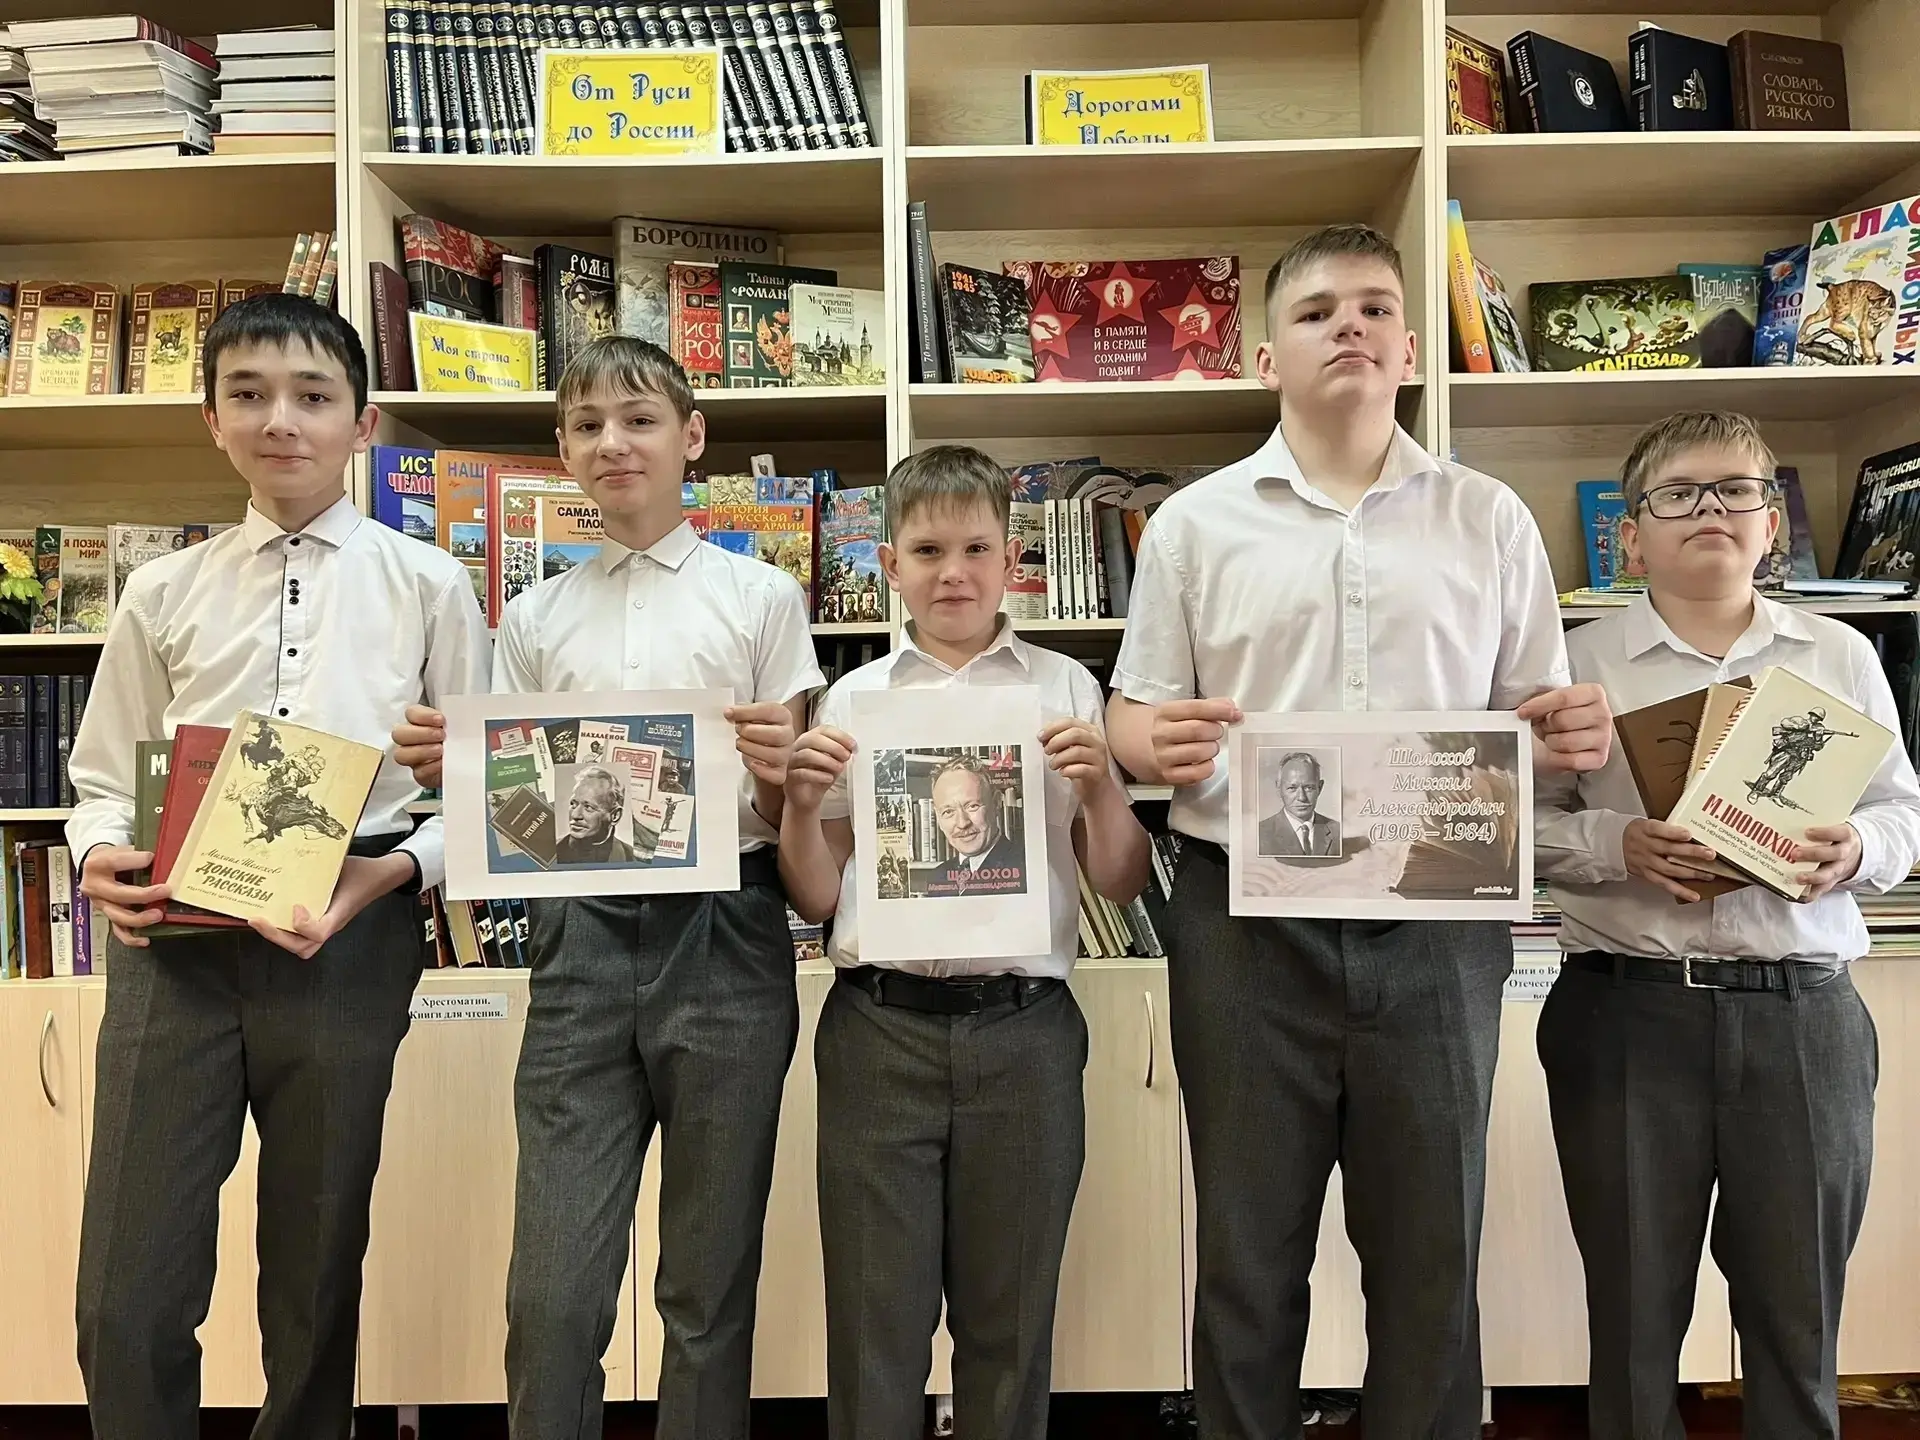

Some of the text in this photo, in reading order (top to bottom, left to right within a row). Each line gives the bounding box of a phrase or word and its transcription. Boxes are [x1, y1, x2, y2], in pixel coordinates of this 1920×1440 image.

[400, 50, 412, 118] ЭНЦИКЛОПЕДИЯ
[424, 51, 437, 119] ЭНЦИКЛОПЕДИЯ
[445, 52, 459, 120] ЭНЦИКЛОПЕДИЯ
[467, 53, 483, 120] ЭНЦИКЛОПЕДИЯ
[490, 53, 506, 121] ЭНЦИКЛОПЕДИЯ
[509, 52, 527, 120] ЭНЦИКЛОПЕДИЯ
[572, 74, 614, 101] От
[628, 72, 691, 106] Руси
[730, 54, 758, 118] ЭНЦИКЛОПЕДИЯ
[752, 53, 778, 117] ЭНЦИКЛОПЕДИЯ
[771, 53, 798, 116] ЭНЦИКЛОПЕДИЯ
[794, 51, 820, 115] ЭНЦИКЛОПЕДИЯ
[815, 50, 841, 115] ЭНЦИКЛОПЕДИЯ
[836, 48, 861, 114] ЭНЦИКЛОПЕДИЯ
[1763, 73, 1824, 91] СЛОВАРЬ
[1062, 90, 1182, 119] Дорогами
[1765, 88, 1835, 109] РУССКОГО
[1766, 104, 1813, 121] ЯЗЫКА
[566, 112, 696, 143] до России
[1078, 123, 1171, 145] Победы
[428, 139, 434, 148] 1
[451, 141, 458, 150] 2
[476, 141, 482, 150] 3
[499, 140, 507, 150] 4
[521, 139, 528, 149] 5
[1813, 198, 1920, 247] АТЛАС
[632, 226, 768, 254] БОРОДИНО
[952, 279, 976, 294] 1945
[1454, 252, 1475, 323] ЭНЦИКЛОПЕДИЯ
[1094, 325, 1147, 338] В ПАМЯТИ
[431, 335, 510, 364] Моя страна
[1094, 338, 1147, 351] И В СЕРДЦЕ
[1094, 351, 1147, 365] СОХРАНИМ
[438, 365, 521, 389] моя Отчизна
[448, 462, 492, 479] НАШ
[503, 481, 562, 490] ЭНЦИКЛОПЕДИЯ
[557, 507, 599, 518] САМАЯ
[714, 505, 769, 514] ИСТОРИЯ
[733, 513, 787, 522] РУССКОЙ
[763, 522, 805, 530] АРМИИ
[64, 539, 108, 549] Я ПОЗНА
[79, 550, 101, 559] МИР
[1052, 607, 1057, 615] 1
[1064, 607, 1070, 615] 2
[1078, 606, 1083, 615] 3
[1090, 604, 1097, 614] 4
[648, 727, 682, 737] ШОЛОХОВ
[988, 751, 1014, 771] 24
[1387, 746, 1476, 767] Шолохов
[1392, 773, 1472, 792] Михаил
[1358, 797, 1506, 821] Александрович
[1368, 822, 1498, 845] (1905 1984)
[1705, 819, 1717, 829] ОНИ
[1718, 826, 1748, 848] СРАЖАЛИСЬ
[1756, 849, 1778, 864] РОДИНУ
[1690, 819, 1706, 831] НАУКА
[1759, 858, 1784, 877] ЧЕЛОВЕКА
[201, 848, 283, 874] Михаил Шолохов
[195, 861, 266, 886] ДОНСКИЕ
[947, 868, 1020, 881] ШОЛОХОВ
[202, 875, 274, 902] РАССКАЗЫ
[55, 851, 66, 965] ЛИТЕРАТУРА ИСКУССТВО
[422, 998, 491, 1008] Хрестоматии.
[410, 1010, 442, 1019] Книги
[465, 1010, 503, 1018] чтения.
